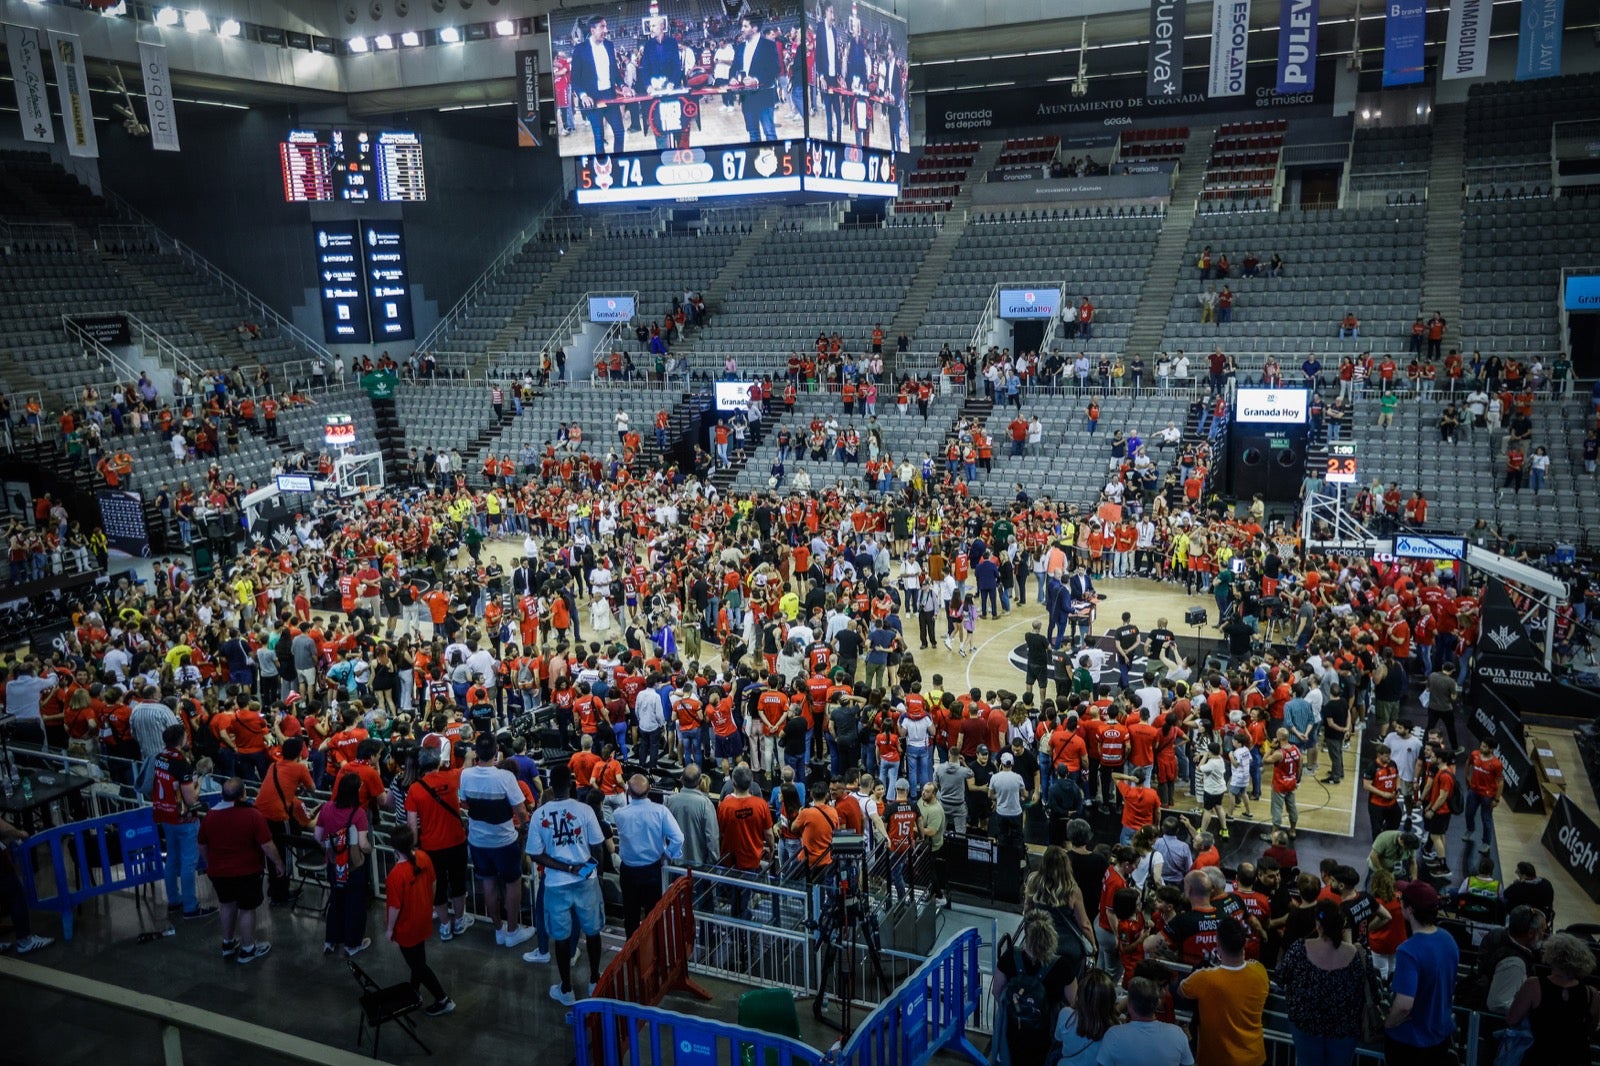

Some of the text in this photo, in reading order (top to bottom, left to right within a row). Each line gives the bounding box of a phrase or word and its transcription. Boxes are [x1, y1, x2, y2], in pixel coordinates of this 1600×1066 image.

[1401, 7, 1423, 16] travel
[1154, 0, 1175, 95] uerva
[1229, 2, 1248, 92] ESCOLANO
[525, 56, 534, 111] BERNER
[148, 63, 168, 132] niobio
[1271, 93, 1313, 106] música
[1037, 99, 1124, 115] AYUNTAMIENTO
[1128, 98, 1143, 108] DE
[945, 109, 992, 121] Granada
[945, 119, 992, 129] es deporte
[785, 141, 791, 153] F
[581, 156, 588, 167] F
[722, 151, 746, 181] 67
[782, 155, 793, 176] 5
[806, 155, 811, 175] 5
[824, 150, 836, 178] 74
[868, 156, 879, 182] 67
[582, 170, 592, 189] 5
[618, 158, 643, 187] 74
[1003, 172, 1032, 181] Granada
[328, 255, 354, 263] emasagra
[377, 254, 401, 262] emasagra
[1008, 305, 1052, 314] Granada Hoy
[1243, 408, 1299, 419] Granada Hoy
[1327, 458, 1355, 474] 2.3
[1478, 667, 1552, 683] CAJA RURAL
[1492, 677, 1535, 688] GRANADA
[550, 810, 574, 847] LA
[898, 821, 911, 836] 15
[1558, 824, 1600, 875] alight
